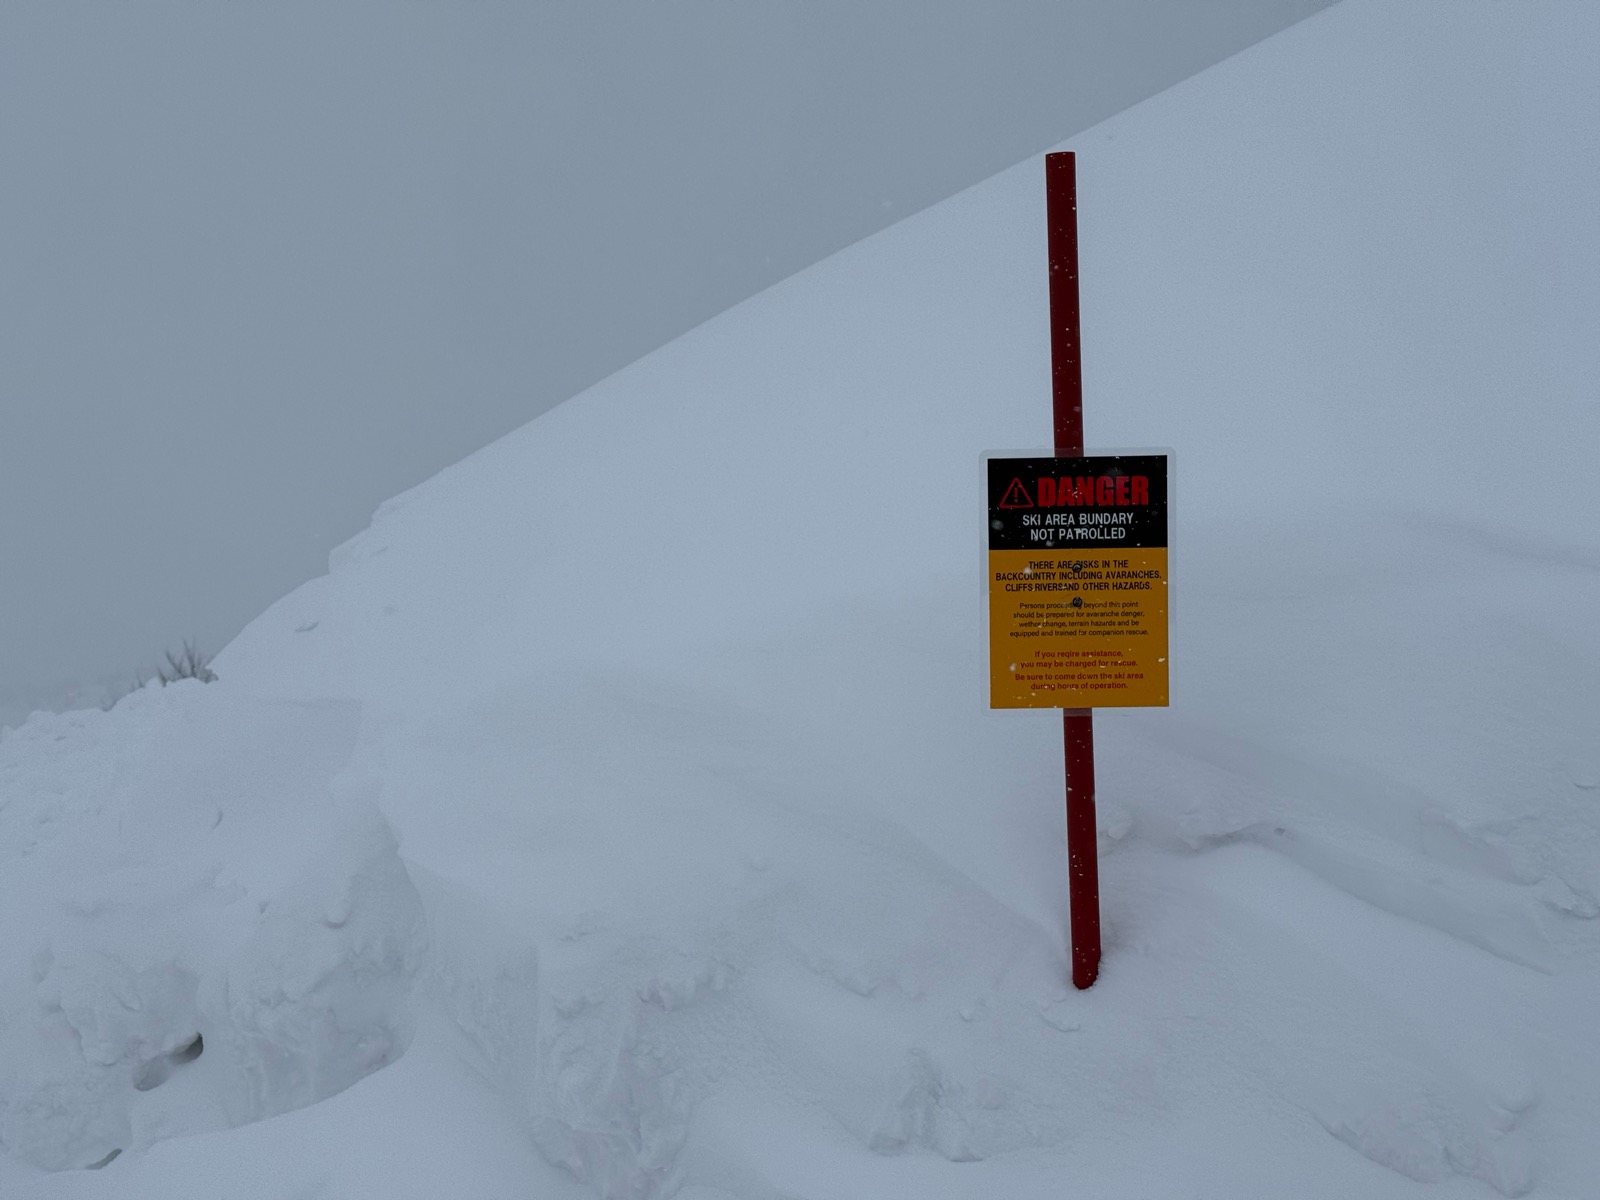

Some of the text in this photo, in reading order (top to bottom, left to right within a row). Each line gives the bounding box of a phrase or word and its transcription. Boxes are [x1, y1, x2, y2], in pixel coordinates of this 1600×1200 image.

[1037, 475, 1149, 507] DANGER
[1022, 512, 1134, 526] SKI AREA BUNDARY
[1030, 527, 1126, 540] NOT PATROLLED
[1028, 561, 1054, 570] THERE
[1076, 560, 1098, 568] ISKS
[996, 572, 1056, 580] BACKCOUNTRY
[1082, 582, 1110, 590] OTHER
[1112, 581, 1152, 590] HAZARDS.
[1066, 660, 1096, 668] charged
